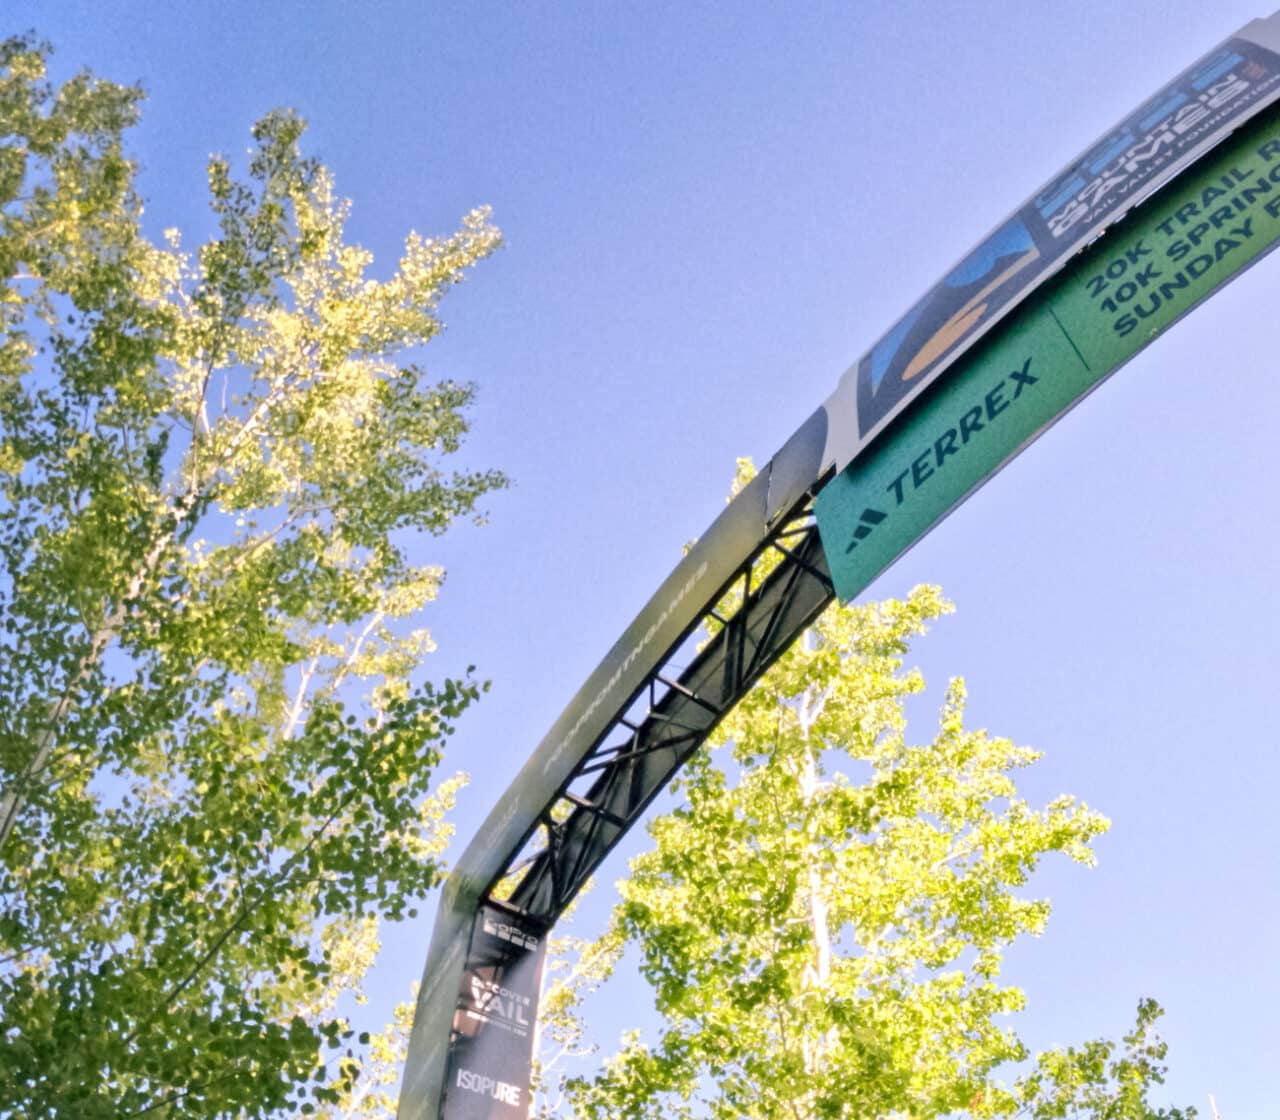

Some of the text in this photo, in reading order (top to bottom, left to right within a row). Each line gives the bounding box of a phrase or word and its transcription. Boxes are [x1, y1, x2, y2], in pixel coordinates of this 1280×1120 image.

[1047, 73, 1238, 230] MOUNTAIN
[1050, 80, 1250, 238] GAMES
[1085, 240, 1153, 299] 20K
[1155, 167, 1255, 237] TRAIL
[1100, 261, 1163, 313] 10K
[1113, 218, 1257, 337] SUNDAY
[886, 356, 1040, 505] TERREX
[470, 985, 529, 1026] VAIL
[456, 1068, 522, 1107] ISOPURE
